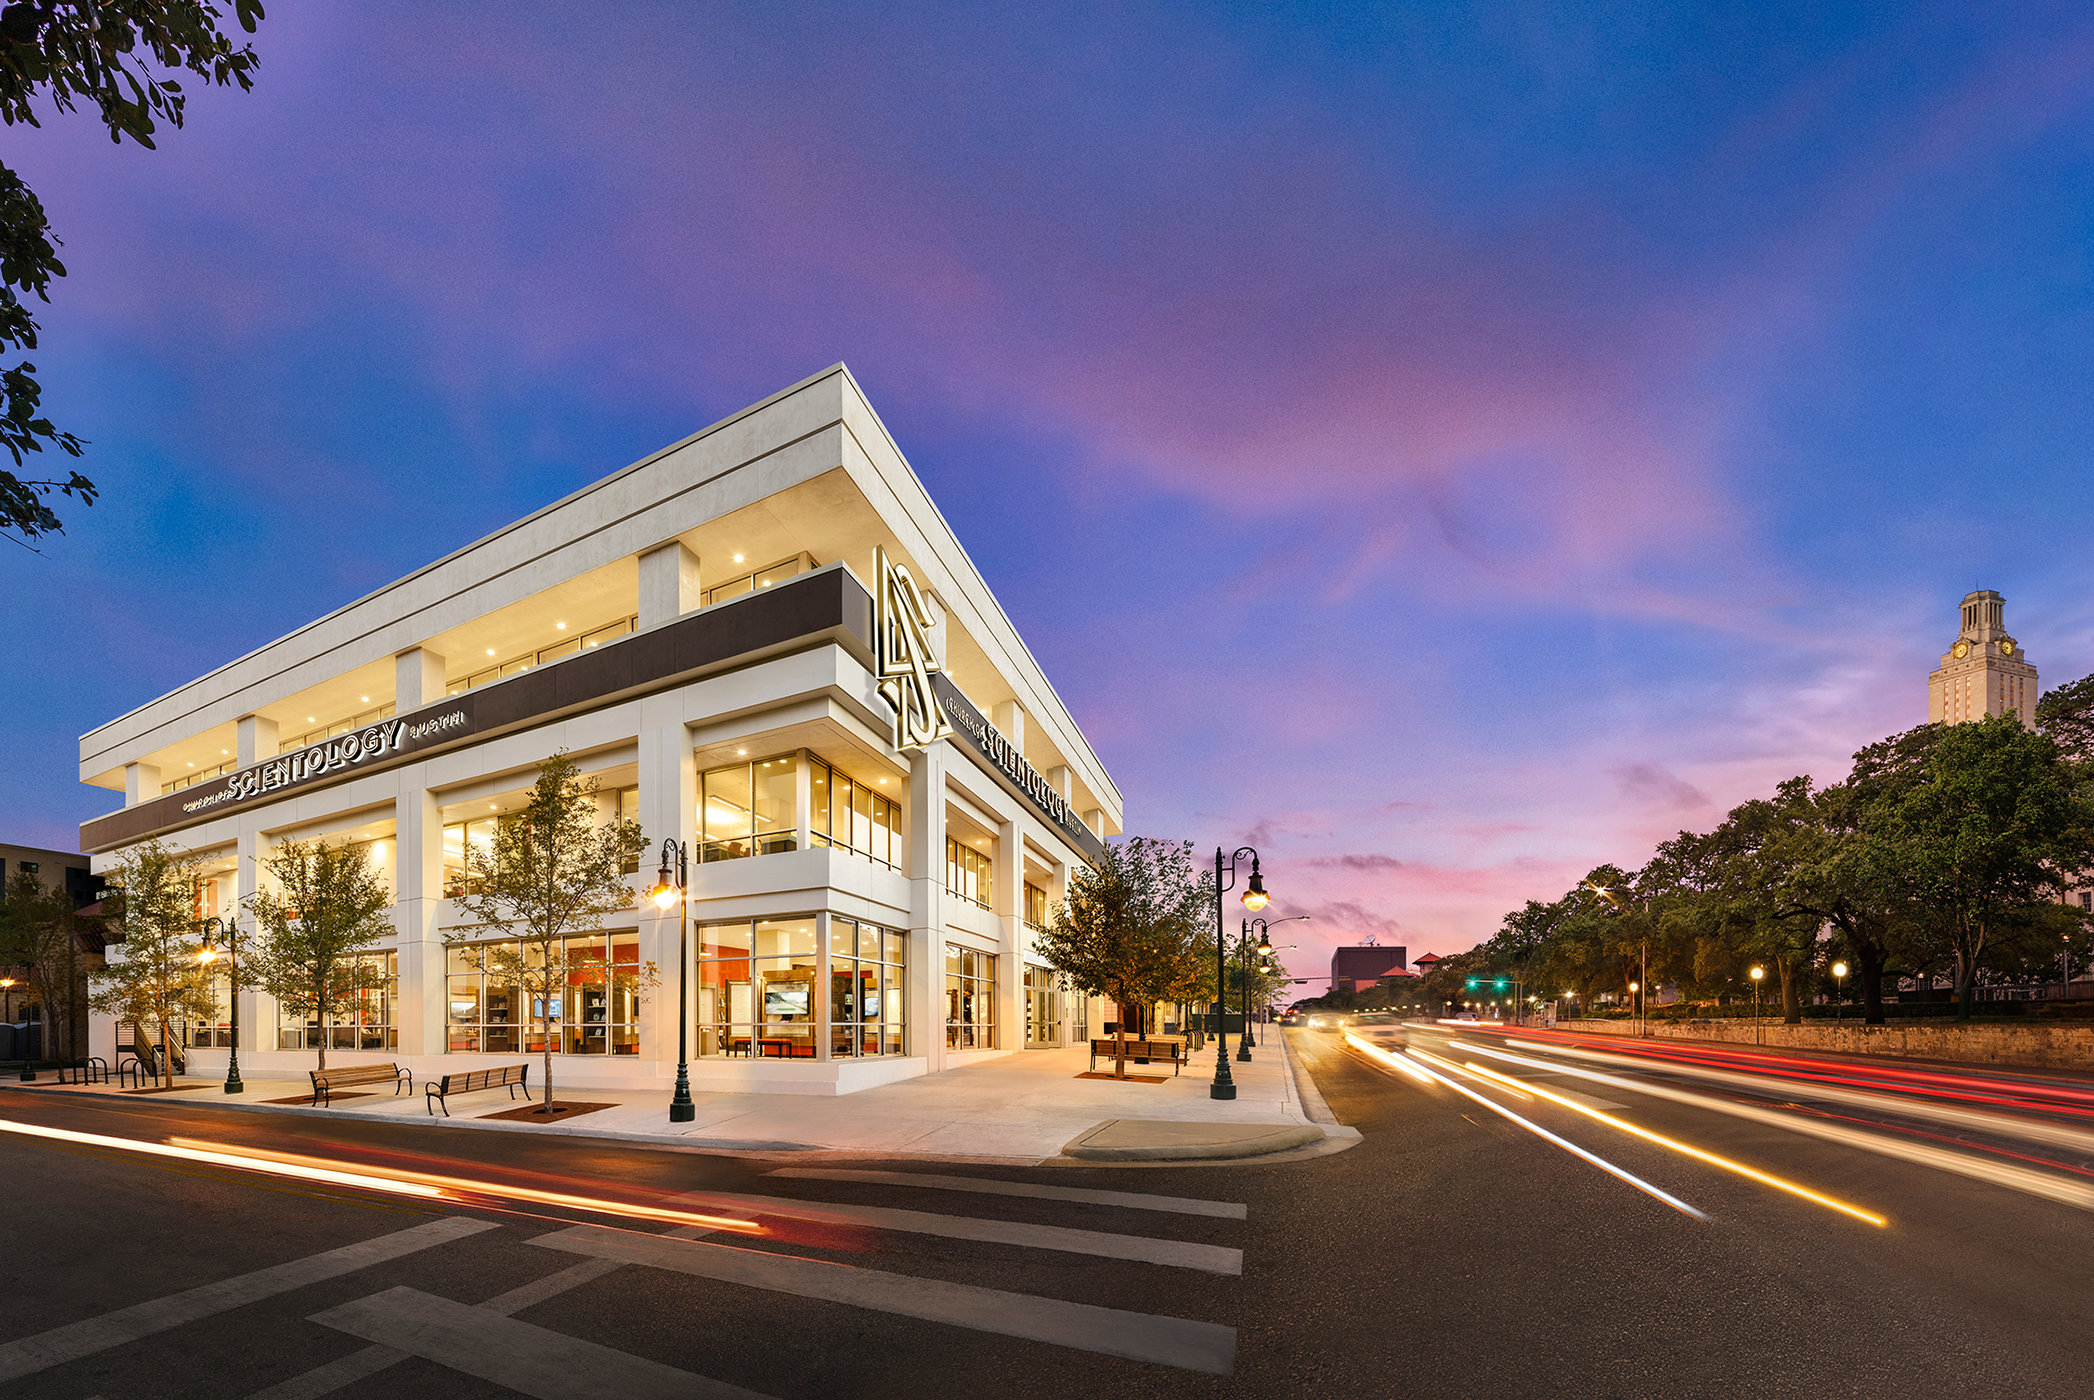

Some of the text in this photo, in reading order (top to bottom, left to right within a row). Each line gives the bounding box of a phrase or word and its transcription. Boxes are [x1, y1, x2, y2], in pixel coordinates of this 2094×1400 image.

[218, 790, 231, 801] OF
[228, 720, 407, 801] SCIENTOLOGY
[409, 711, 465, 737] AUSTIN
[946, 697, 974, 730] CHURCH
[981, 725, 1069, 824] SCIENTOLOGY
